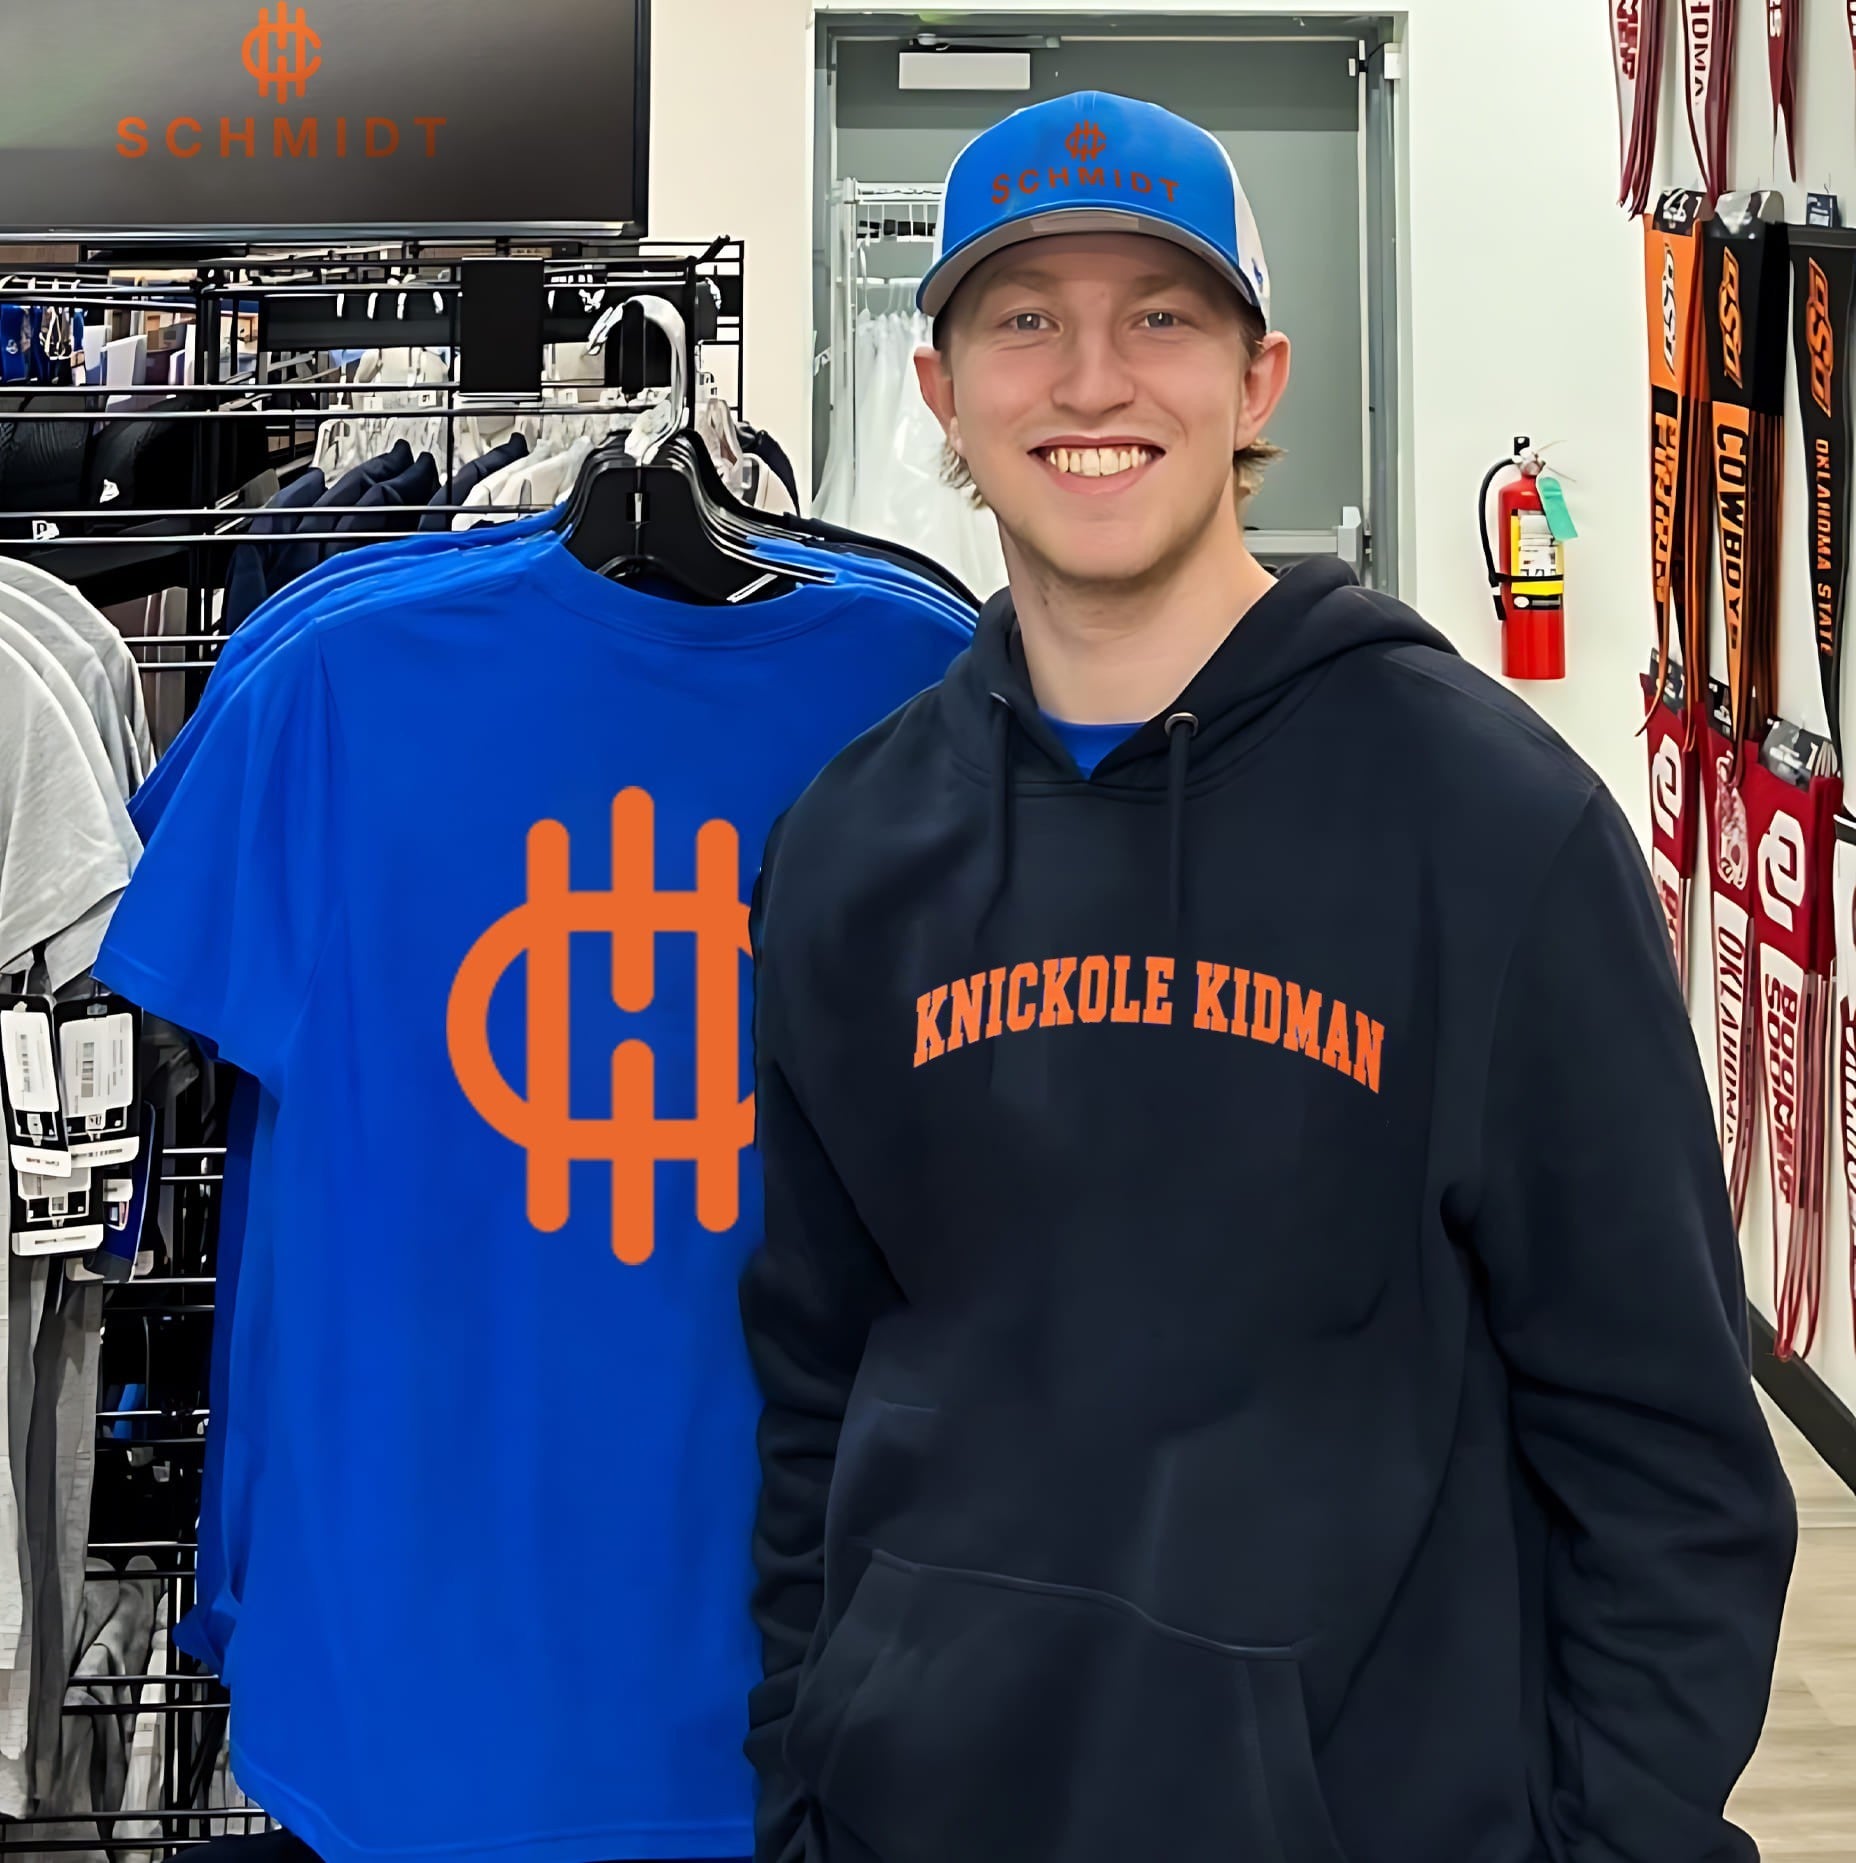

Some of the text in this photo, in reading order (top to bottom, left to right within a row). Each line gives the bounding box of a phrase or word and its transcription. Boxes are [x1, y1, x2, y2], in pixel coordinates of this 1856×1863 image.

[116, 117, 447, 158] SCHMIDT
[991, 166, 1179, 205] SCHMIDT
[1816, 439, 1832, 570] OKLAHOMA
[913, 955, 1385, 1094] KNICKOLE KIDMAN
[1718, 927, 1745, 1144] OKLAHOMA
